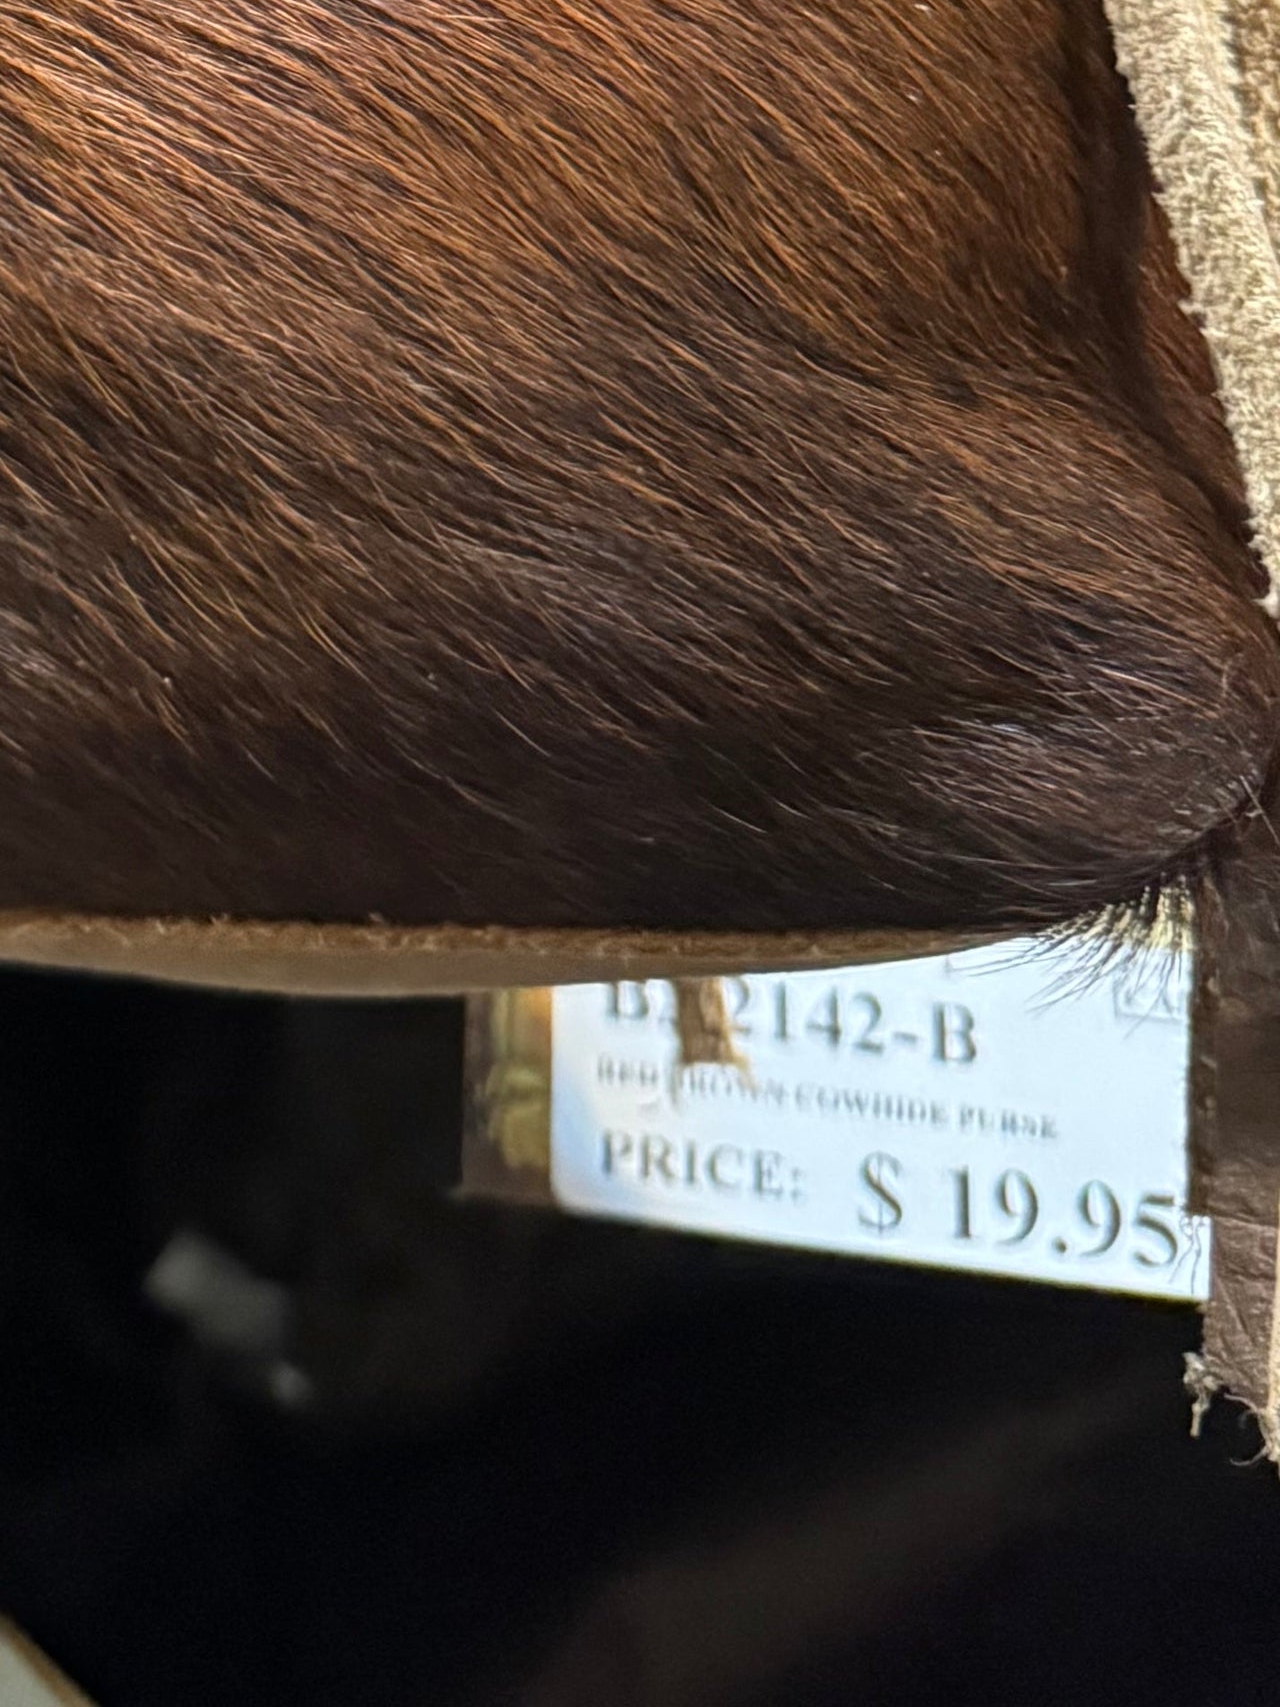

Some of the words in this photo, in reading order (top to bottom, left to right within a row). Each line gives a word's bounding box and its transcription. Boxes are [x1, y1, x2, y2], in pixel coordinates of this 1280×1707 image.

[601, 1130, 805, 1201] PRICE:
[857, 1150, 903, 1234] $
[952, 1164, 1179, 1269] 19.95
